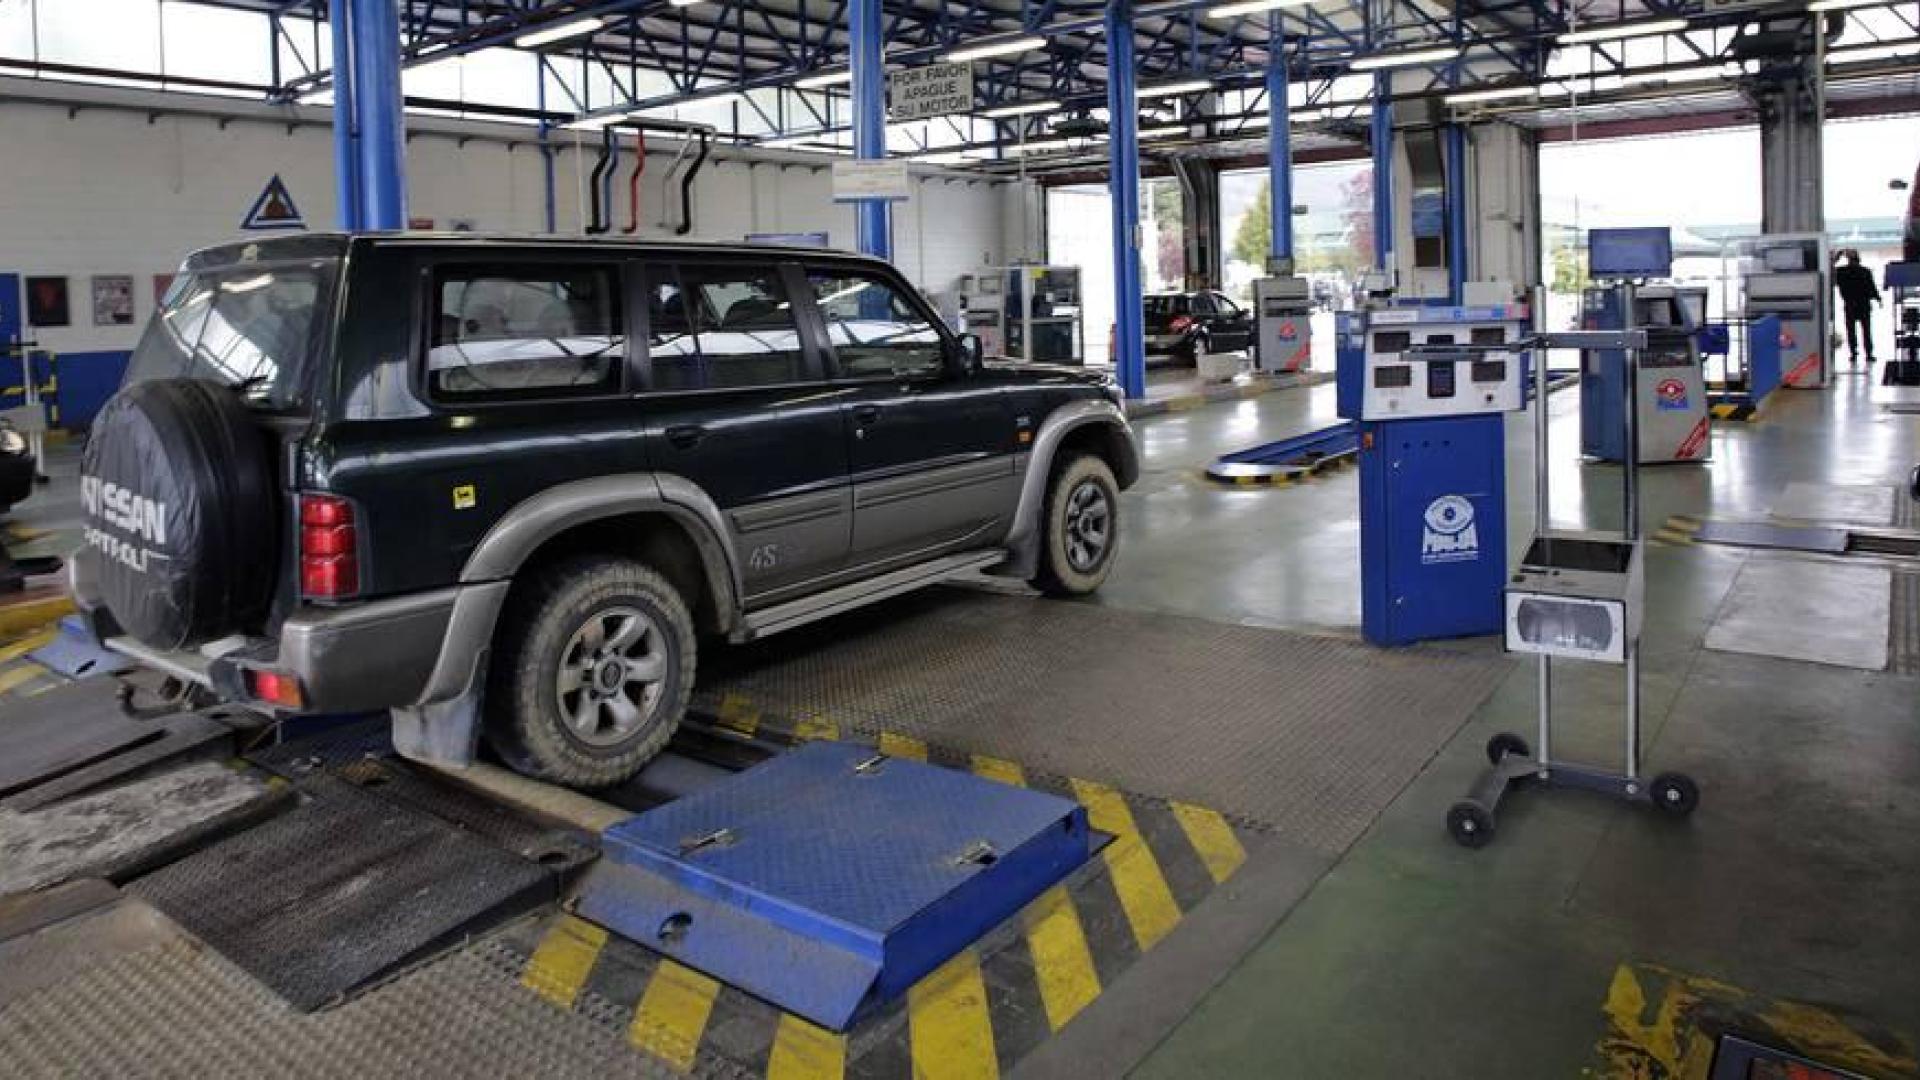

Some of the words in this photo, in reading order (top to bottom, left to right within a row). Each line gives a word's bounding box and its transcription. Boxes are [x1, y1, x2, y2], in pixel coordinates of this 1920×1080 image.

[926, 63, 969, 80] FAVOR
[904, 81, 957, 99] APAGUE
[897, 103, 915, 117] SU
[920, 95, 968, 113] MOTOR
[81, 475, 166, 545] NISSAN
